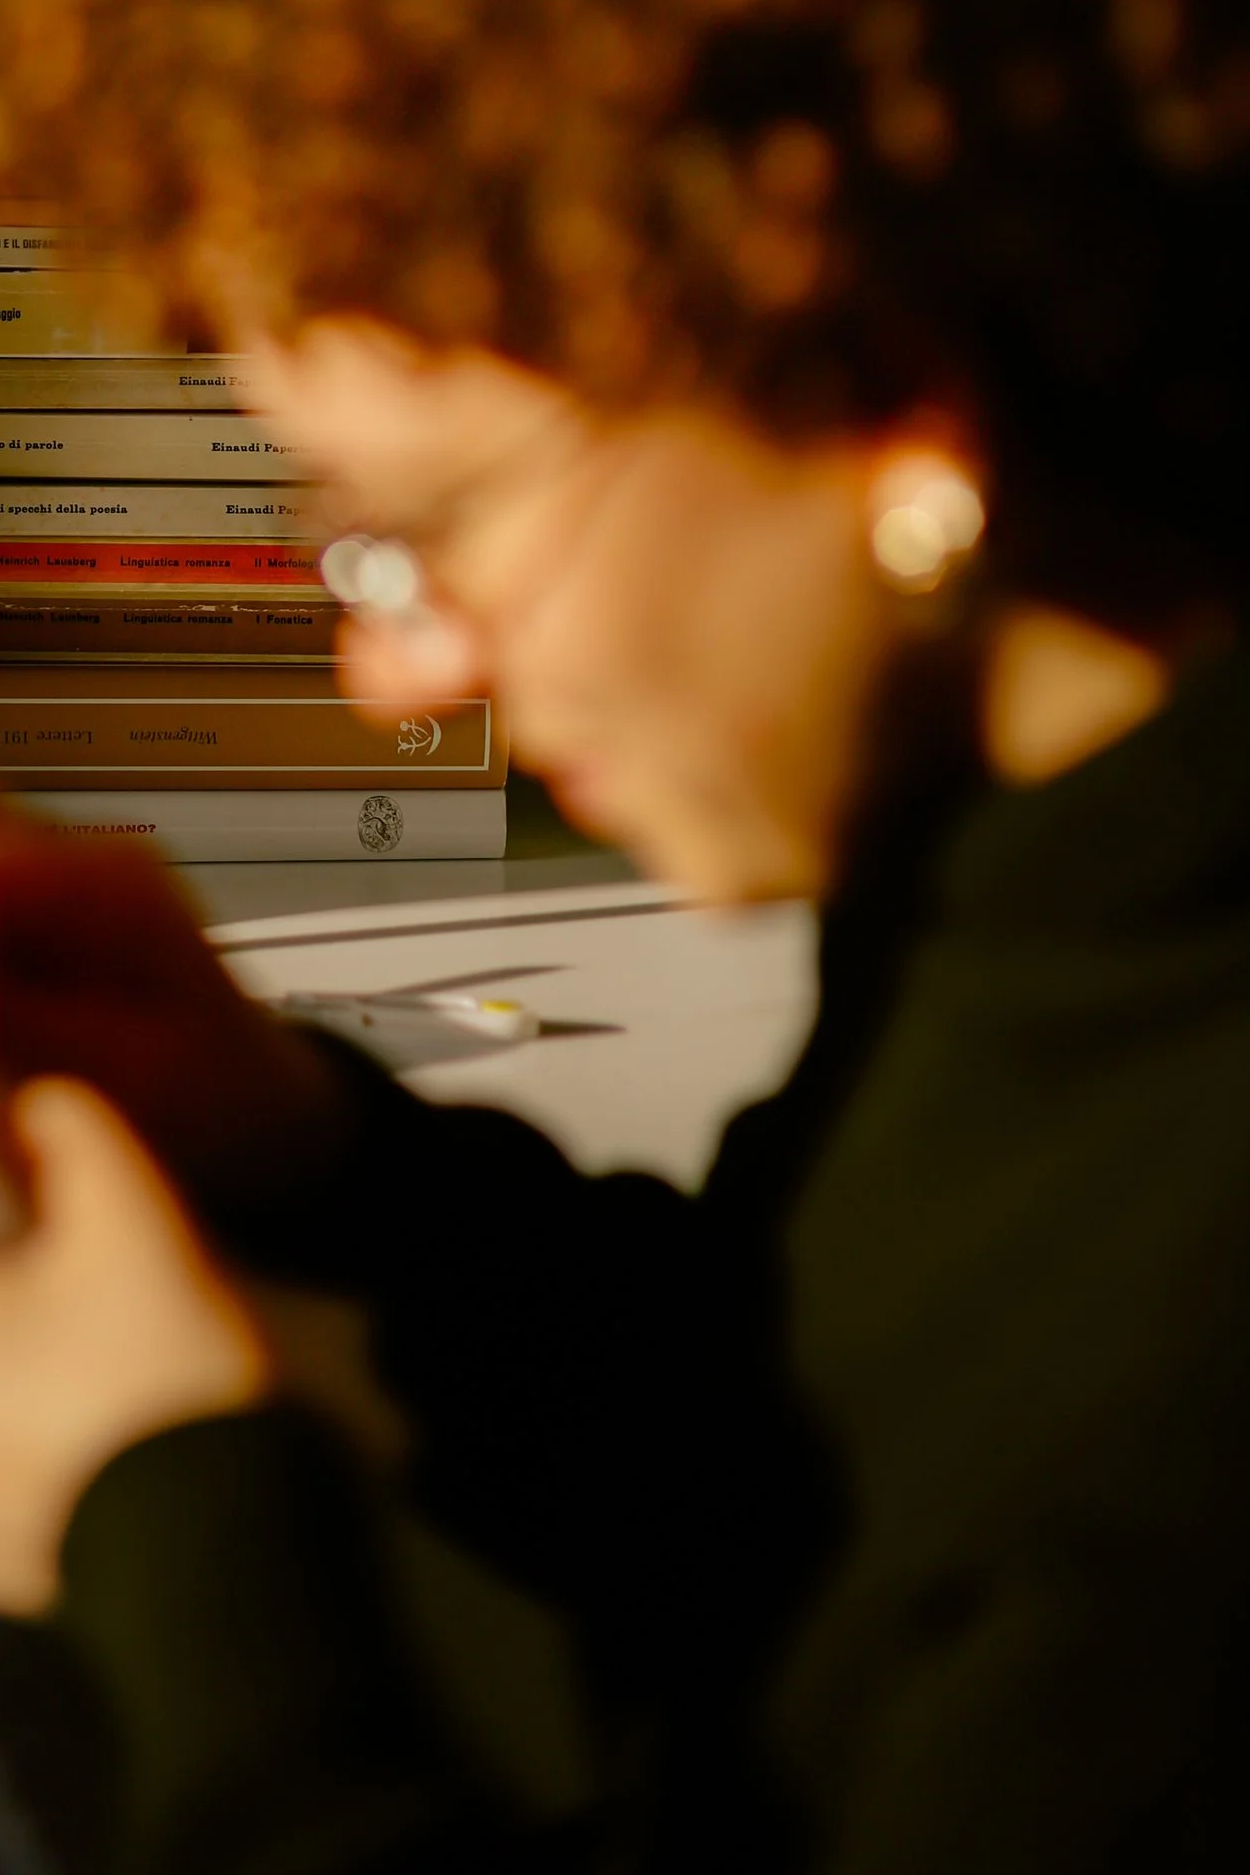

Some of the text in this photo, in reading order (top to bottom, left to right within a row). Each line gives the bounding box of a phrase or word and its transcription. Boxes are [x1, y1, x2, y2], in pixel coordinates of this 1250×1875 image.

[3, 238, 10, 249] E
[12, 238, 21, 249] IL
[178, 375, 227, 386] Einaudi
[9, 439, 21, 449] di
[24, 440, 64, 451] parole
[212, 442, 260, 453] Einaudi
[8, 503, 53, 516] specchi
[55, 503, 87, 514] della
[89, 504, 128, 516] poesia
[225, 504, 274, 515] Einaudi
[46, 556, 97, 568] Lausberg
[119, 556, 231, 569] Linguistica romanza
[0, 612, 100, 624] Heinrich Lausberg
[123, 613, 233, 625] Linguistica romanza
[266, 614, 313, 625] Fonetica
[37, 730, 94, 744] Lettere
[129, 727, 218, 745] Wittgenstein
